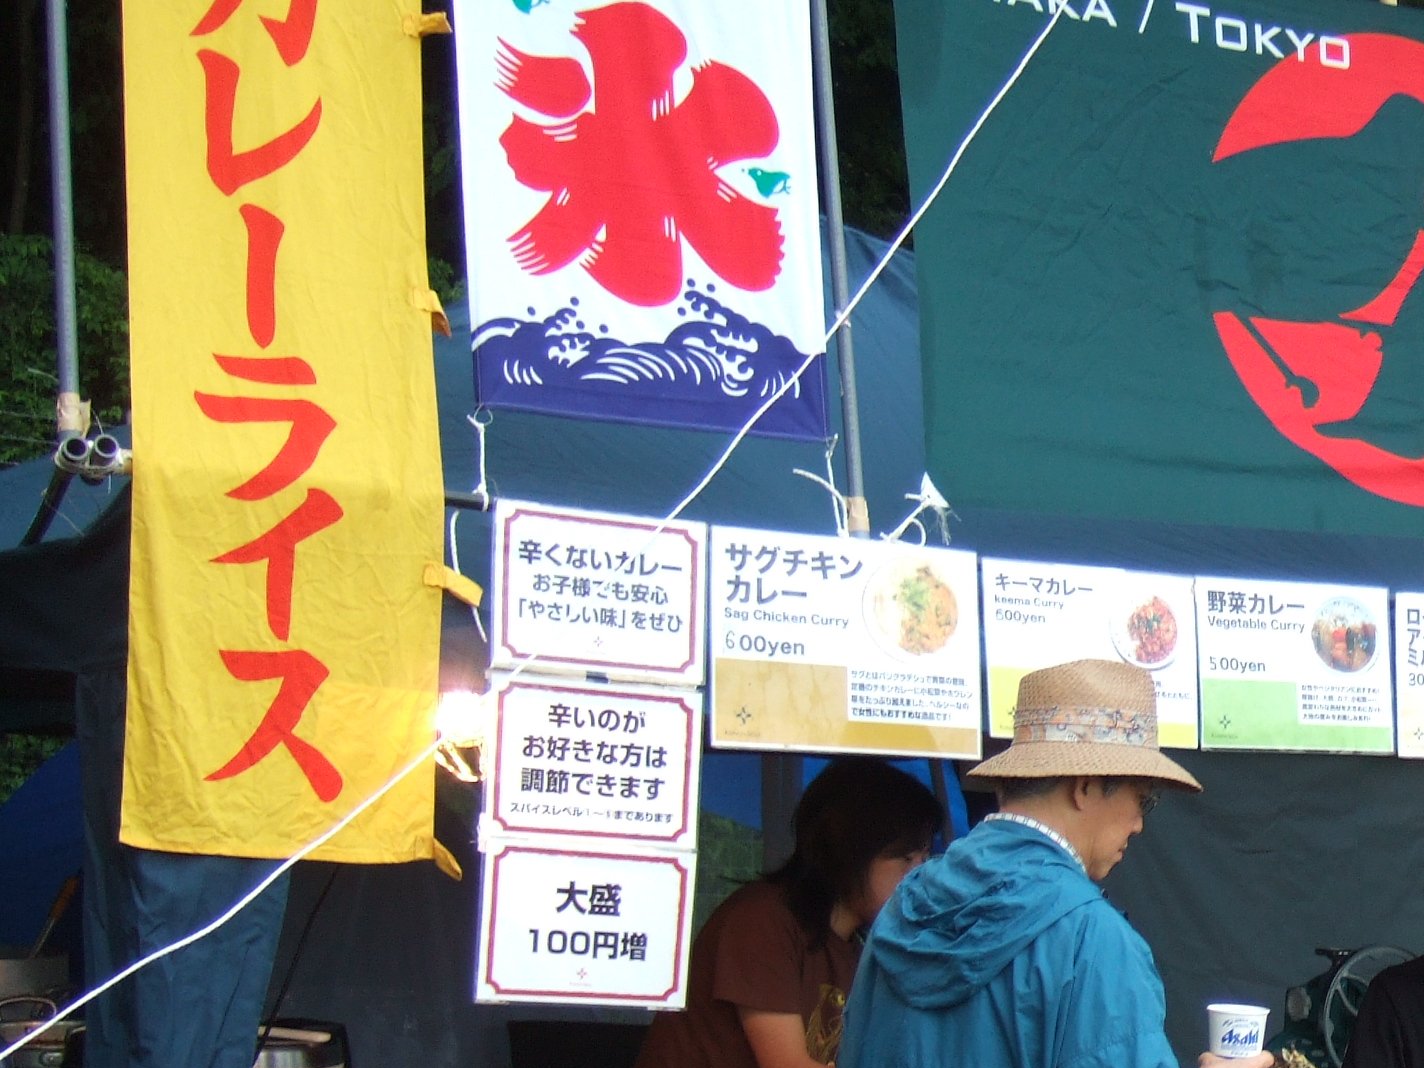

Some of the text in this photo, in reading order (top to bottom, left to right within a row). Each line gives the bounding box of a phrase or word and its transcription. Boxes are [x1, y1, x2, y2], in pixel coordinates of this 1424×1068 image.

[1175, 2, 1351, 70] TOKYO
[494, 0, 787, 307] 氷
[518, 539, 682, 576] 辛くないカレー
[725, 542, 863, 580] サグチキン
[532, 573, 669, 606] お子様でも安心
[726, 574, 808, 605] カレー
[995, 572, 1094, 596] キーマカレー
[724, 606, 850, 629] Sag Chicken Curry
[1034, 597, 1065, 610] Curry
[1207, 589, 1305, 615] 野菜カレー
[1207, 615, 1305, 634] Vegetable Curry
[548, 703, 646, 734] 辛いのが
[522, 735, 668, 768] お好きな方は
[520, 767, 666, 801] 調節できます
[555, 880, 622, 917] 大盛
[529, 928, 648, 962] 100円増
[1221, 1028, 1260, 1046] Asahi
